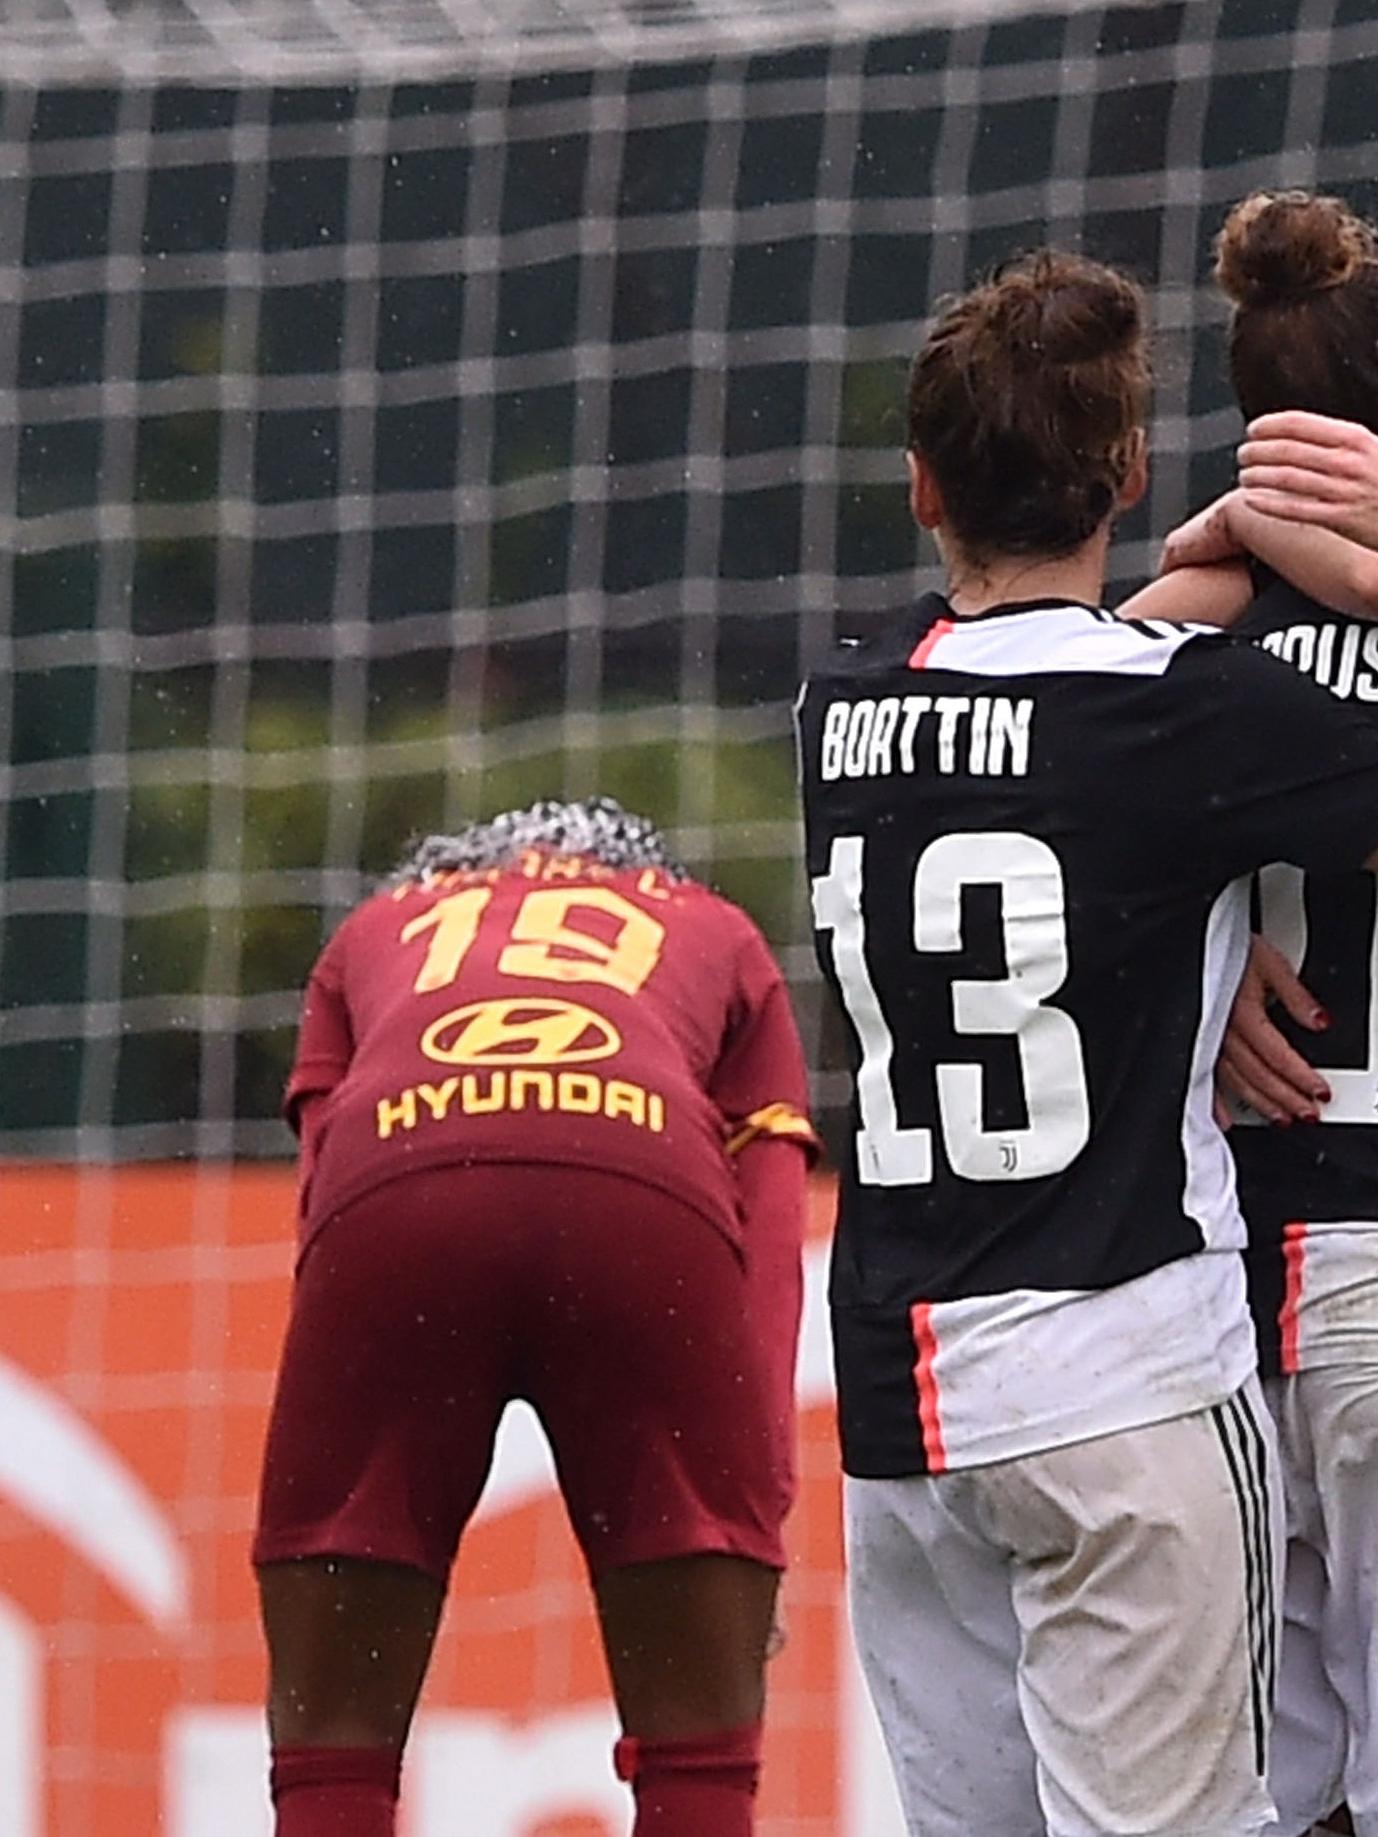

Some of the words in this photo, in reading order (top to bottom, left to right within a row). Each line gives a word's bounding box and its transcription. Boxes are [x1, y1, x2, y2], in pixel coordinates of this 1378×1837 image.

[822, 697, 1034, 780] BOATTIN
[400, 886, 665, 996] 19
[812, 832, 1091, 1186] 13
[376, 1070, 665, 1139] HYUNDAI
